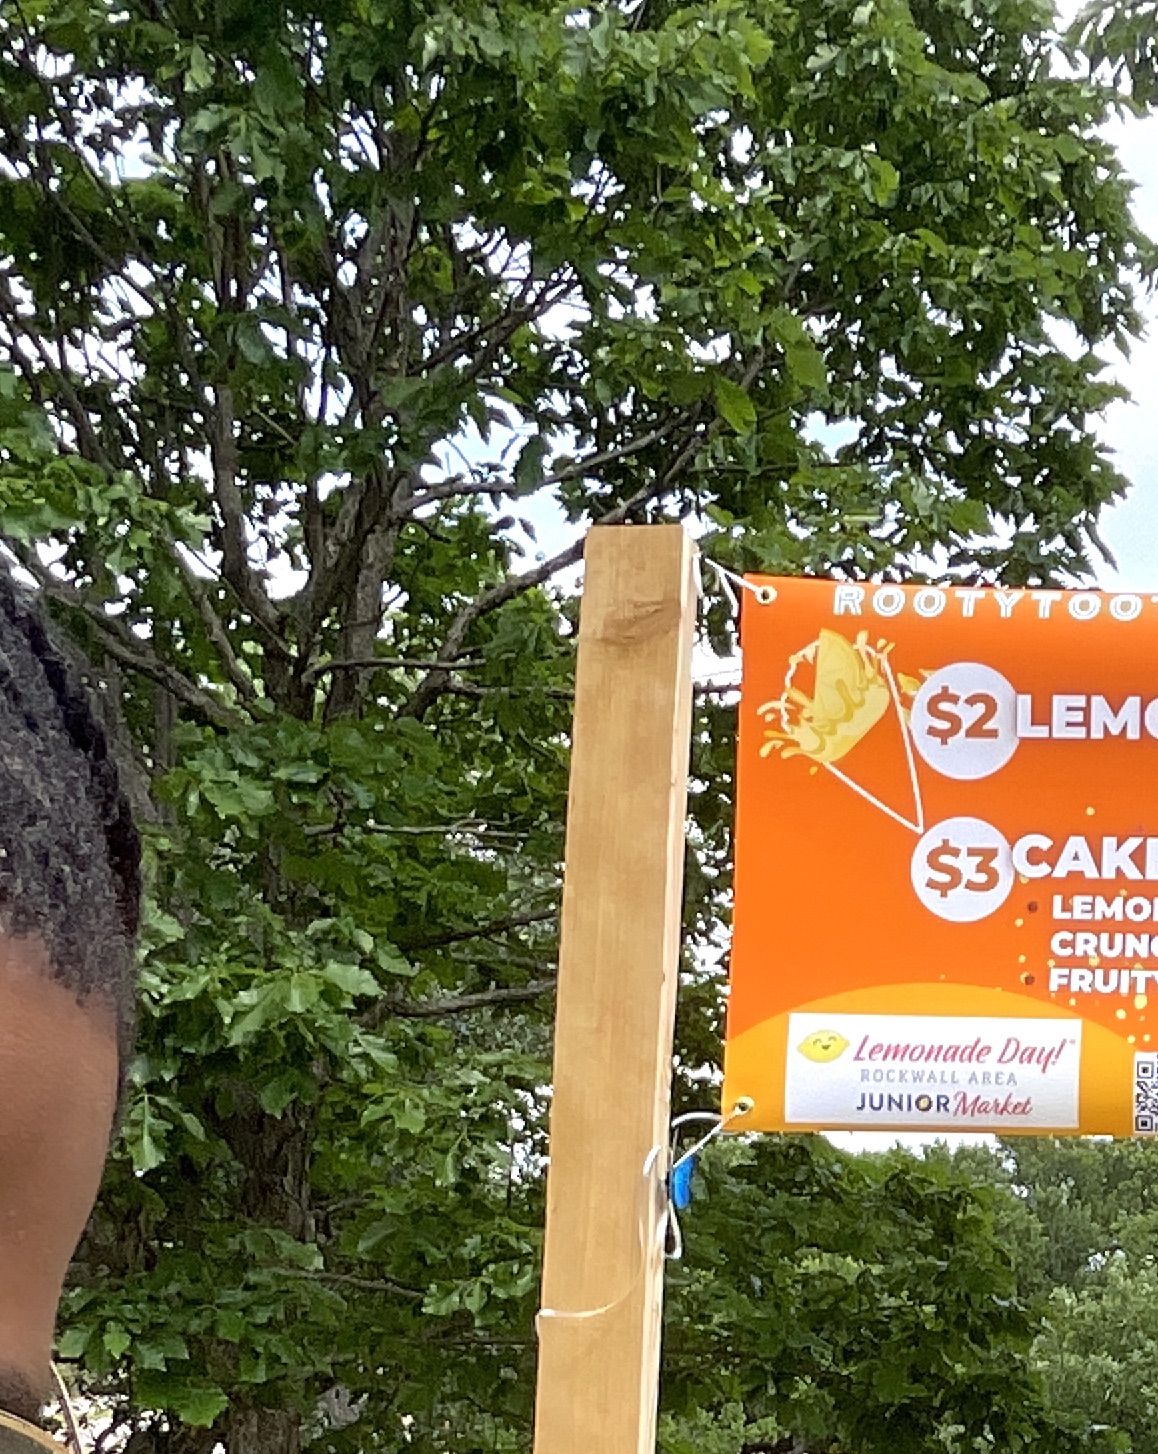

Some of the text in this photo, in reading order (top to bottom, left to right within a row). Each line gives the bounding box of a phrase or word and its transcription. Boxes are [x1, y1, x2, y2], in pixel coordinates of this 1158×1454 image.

[925, 684, 1000, 746] $2
[925, 838, 1001, 899] $3
[853, 1034, 1068, 1073] Lemonade Day!
[860, 1069, 1018, 1086] ROCKWALL AREA
[856, 1091, 1034, 1118] JUNIOR Market
